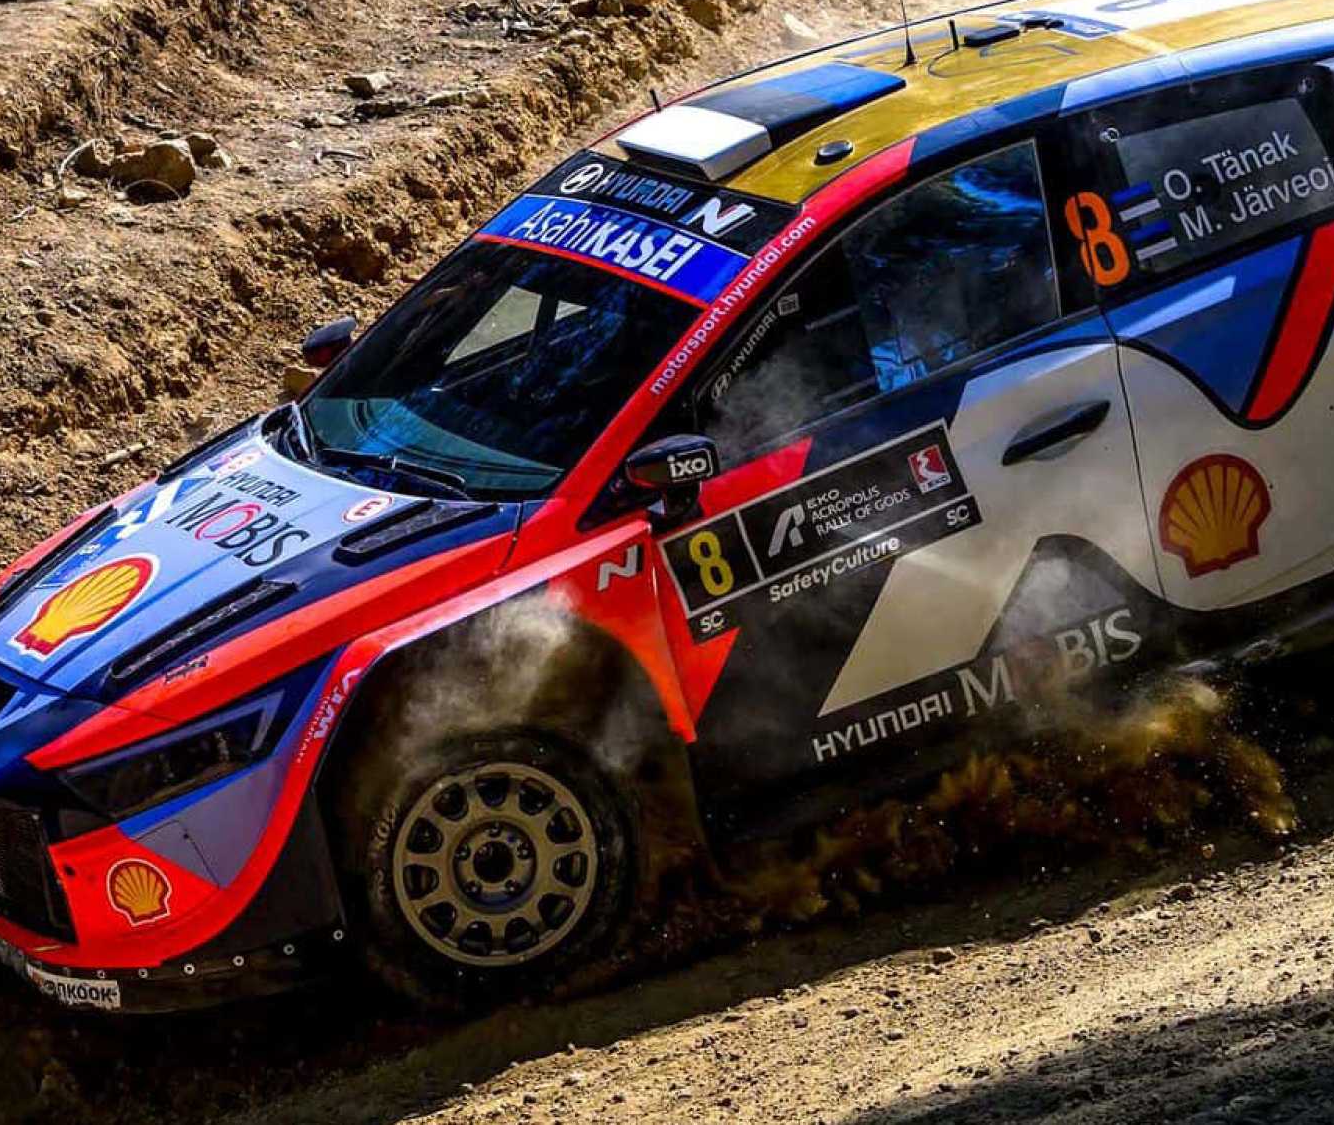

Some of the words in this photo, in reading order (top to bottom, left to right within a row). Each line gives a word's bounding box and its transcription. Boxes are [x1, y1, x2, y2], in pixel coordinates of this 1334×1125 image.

[1164, 169, 1202, 202] O.
[1202, 129, 1300, 183] Tänak
[1065, 191, 1131, 287] 8
[1178, 209, 1223, 245] M.
[650, 215, 817, 396] motorsport.hyundai.com
[222, 471, 301, 507] HYUNDAI
[812, 485, 881, 524] ACROPOLIS
[816, 513, 853, 537] RALLY
[854, 506, 872, 520] OF
[874, 488, 912, 512] GODS
[946, 504, 970, 527] SC
[165, 492, 310, 567] MOBIS
[688, 531, 734, 597] 8
[700, 610, 725, 634] SC
[812, 690, 953, 762] HYUNDAI
